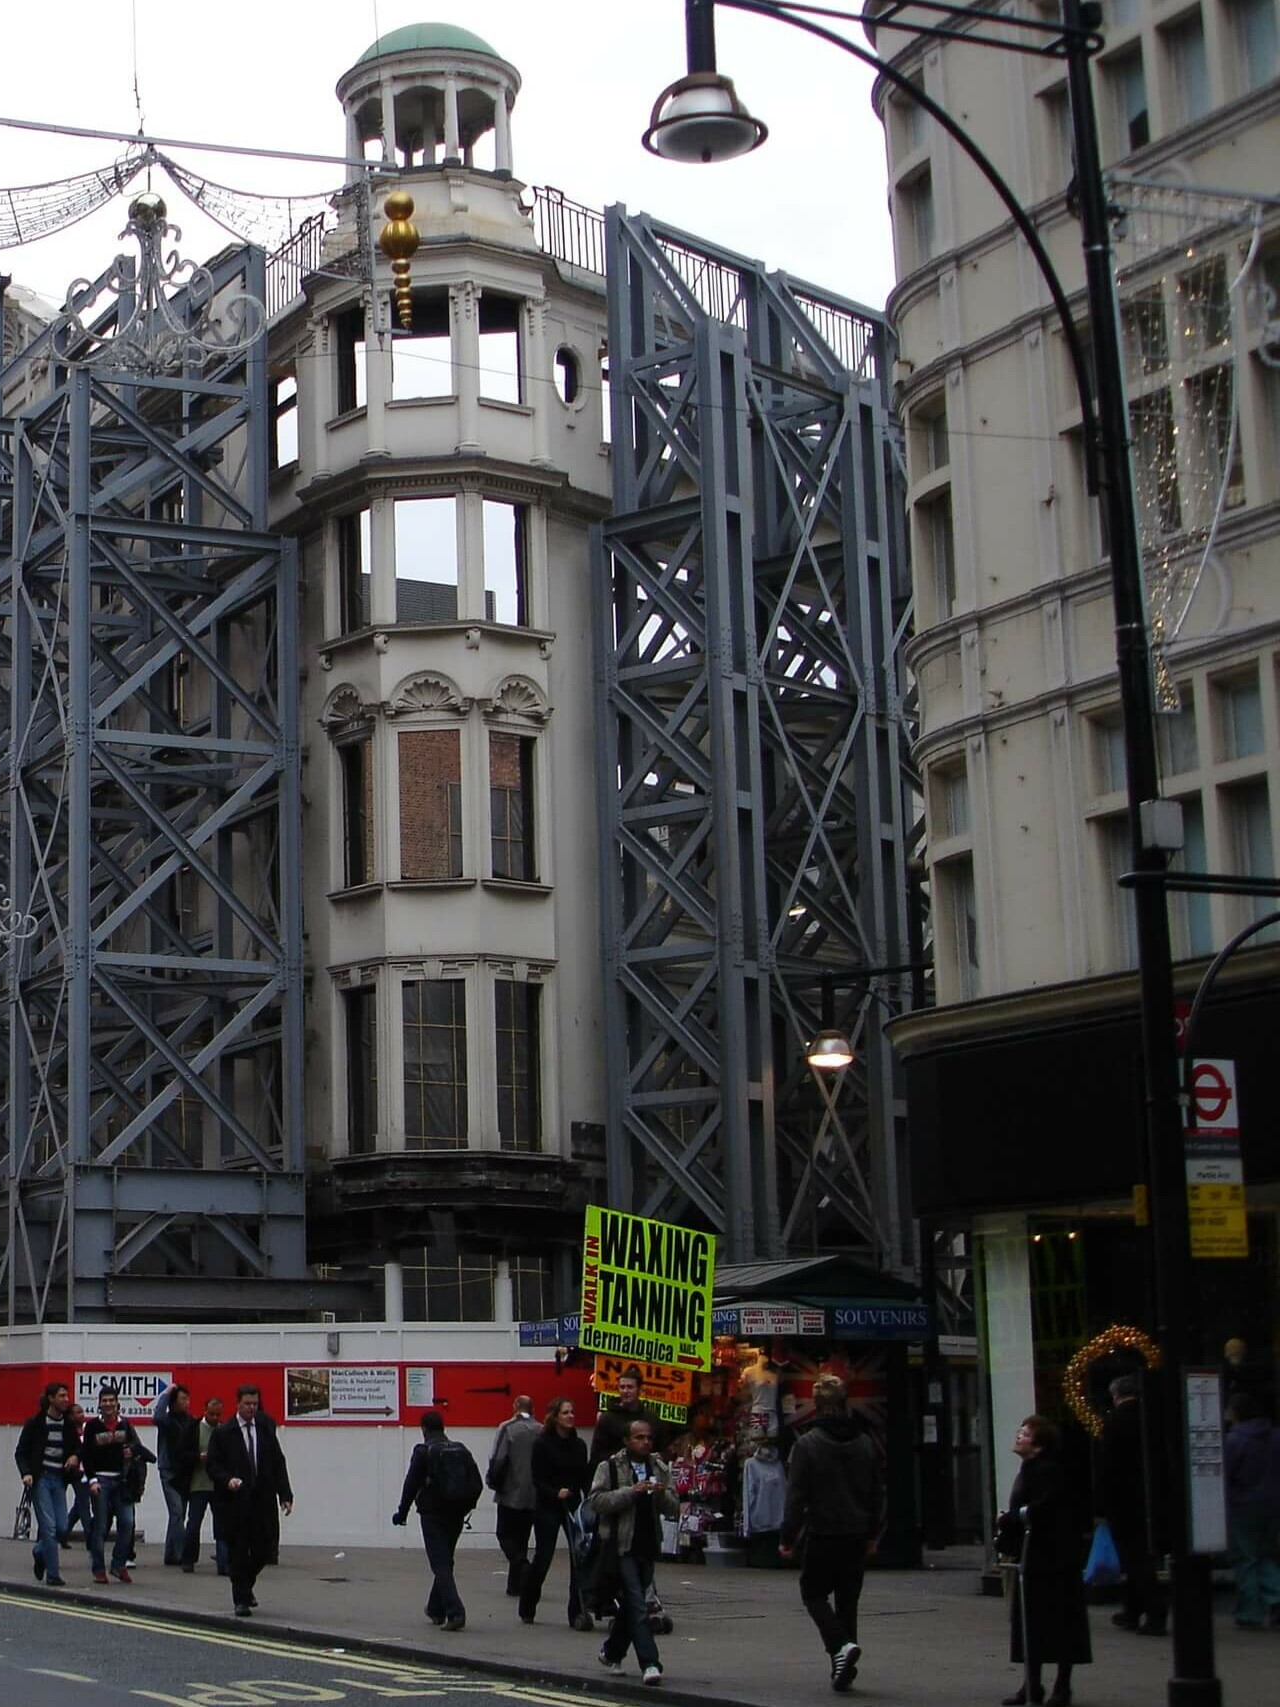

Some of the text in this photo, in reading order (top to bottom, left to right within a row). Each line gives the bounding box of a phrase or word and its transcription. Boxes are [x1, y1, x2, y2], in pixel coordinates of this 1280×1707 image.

[600, 1211, 708, 1288] WAXING
[583, 1235, 600, 1325] WALK IN
[599, 1269, 705, 1343] TANNING
[835, 1309, 928, 1326] SOUVENIRS
[583, 1325, 674, 1363] dermalogica
[99, 1375, 157, 1396] SMITH
[605, 1360, 685, 1383] NAILS
[662, 1403, 686, 1421] £14.99
